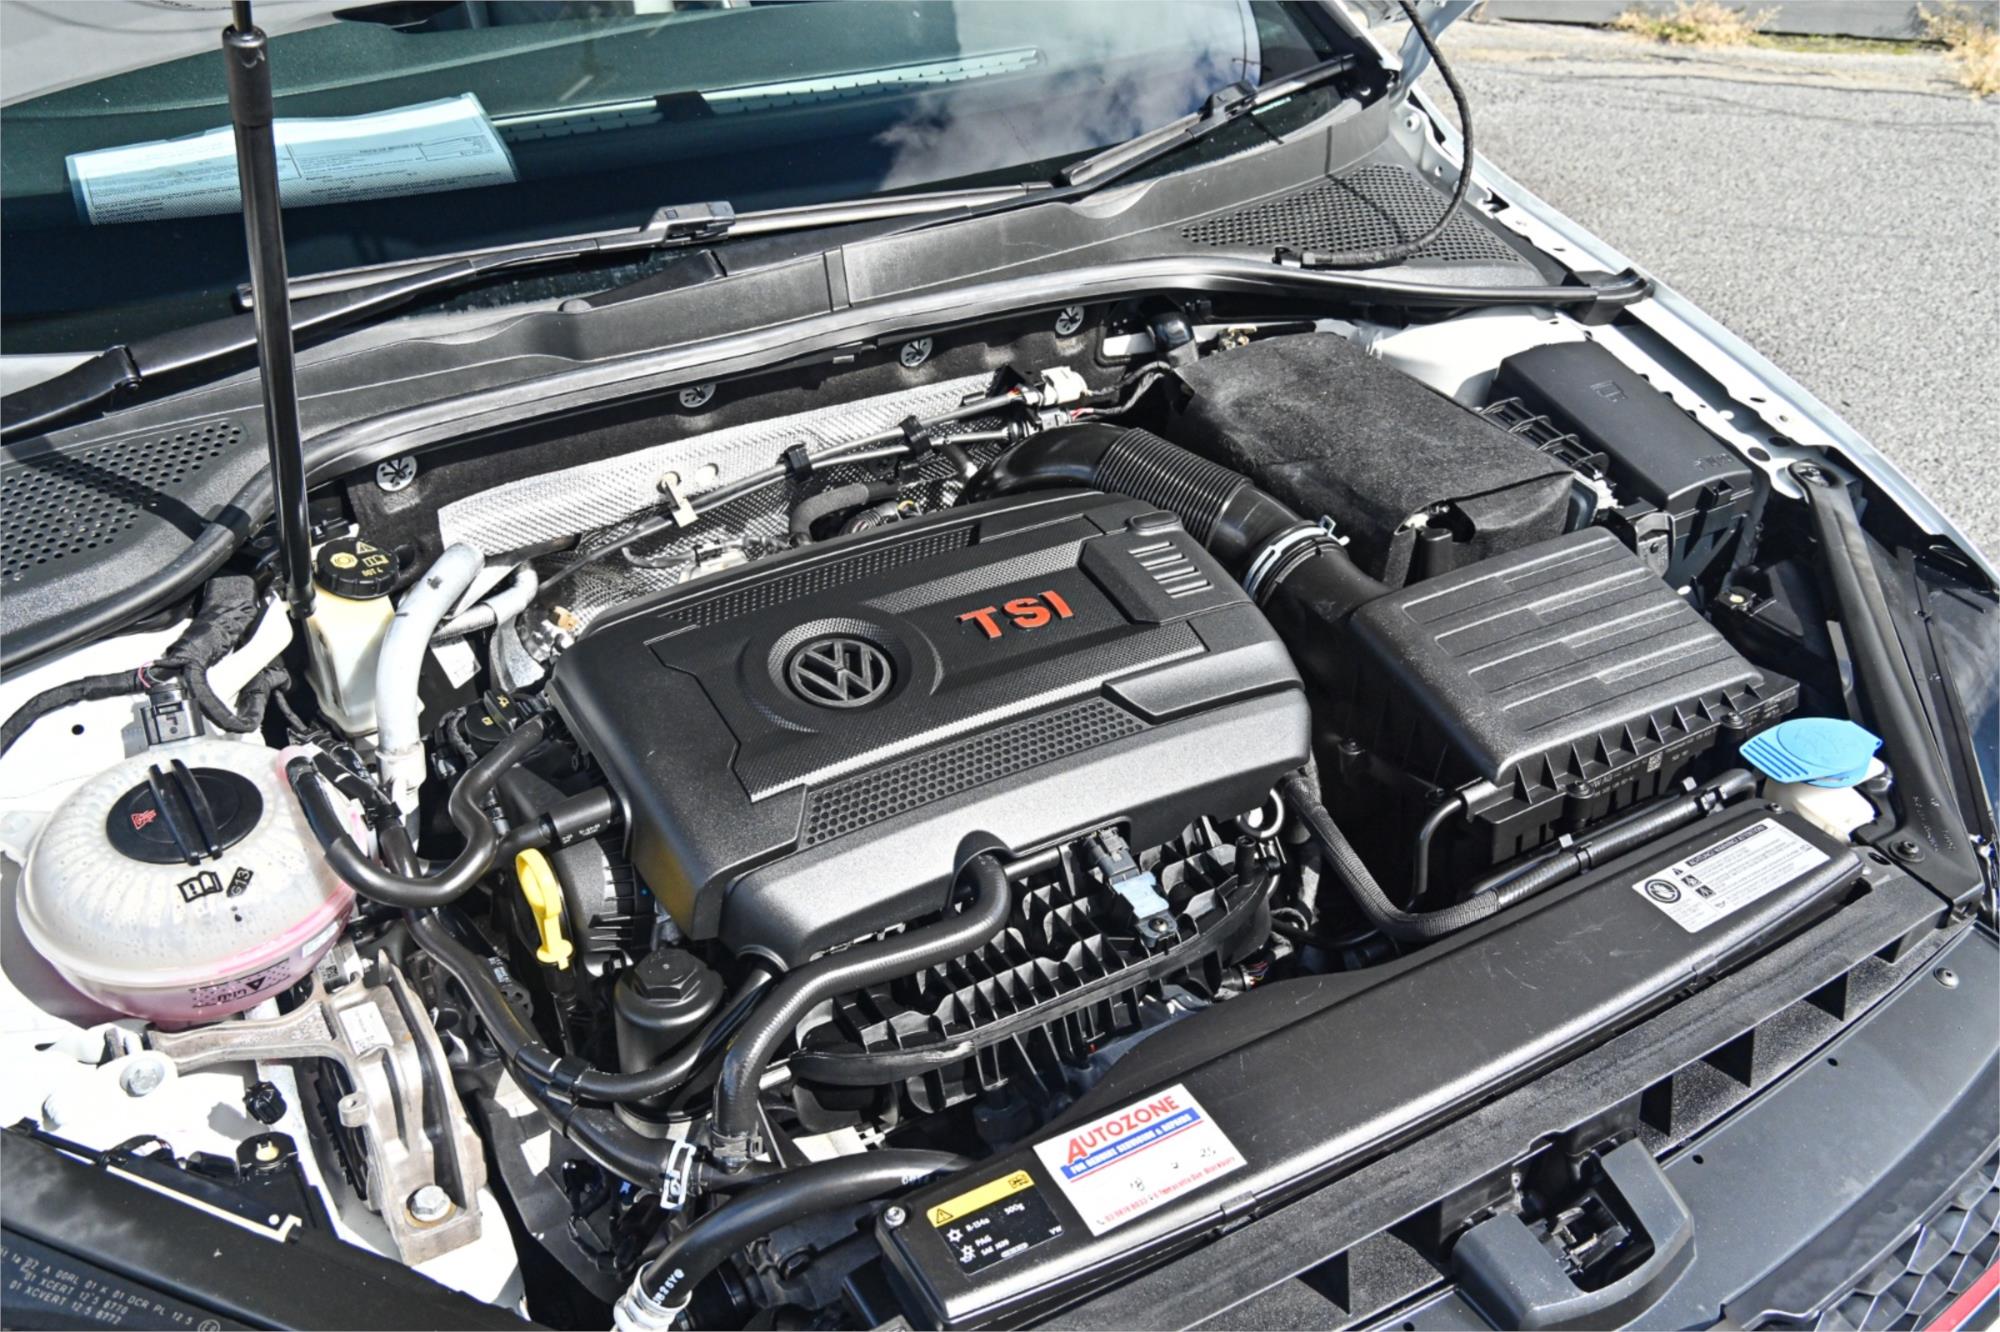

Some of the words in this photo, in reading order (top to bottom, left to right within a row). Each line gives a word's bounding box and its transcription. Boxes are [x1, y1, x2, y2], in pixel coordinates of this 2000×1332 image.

[955, 590, 1073, 639] TSI
[789, 638, 891, 708] VW
[230, 869, 251, 897] G13
[1067, 1096, 1180, 1164] AUTOZONE
